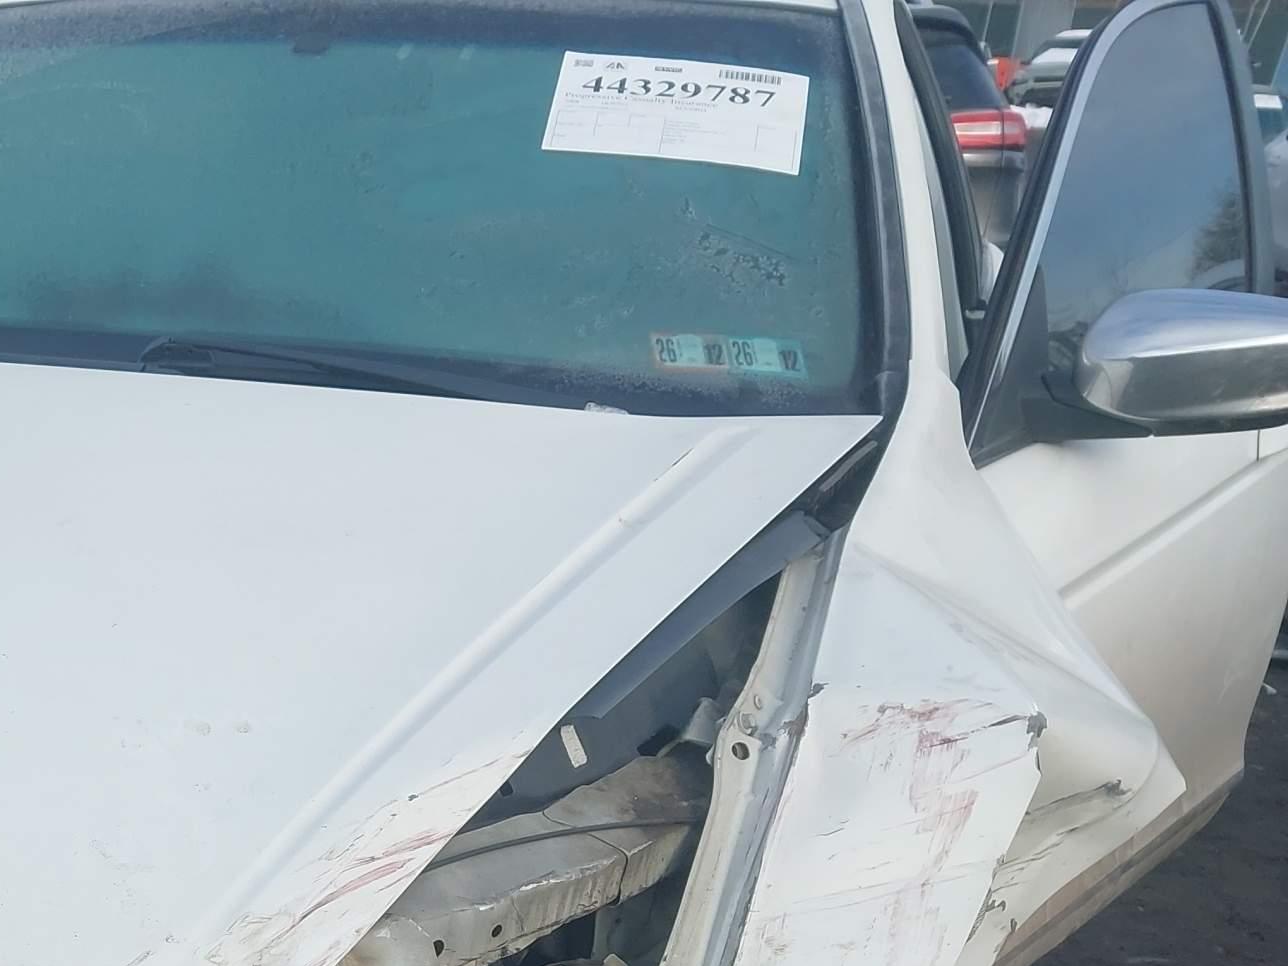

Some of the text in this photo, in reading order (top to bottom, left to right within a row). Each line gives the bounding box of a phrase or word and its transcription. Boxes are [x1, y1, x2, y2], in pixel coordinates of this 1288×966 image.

[581, 75, 777, 108] 44329787
[655, 337, 727, 366] 26 12
[732, 339, 754, 367] 26
